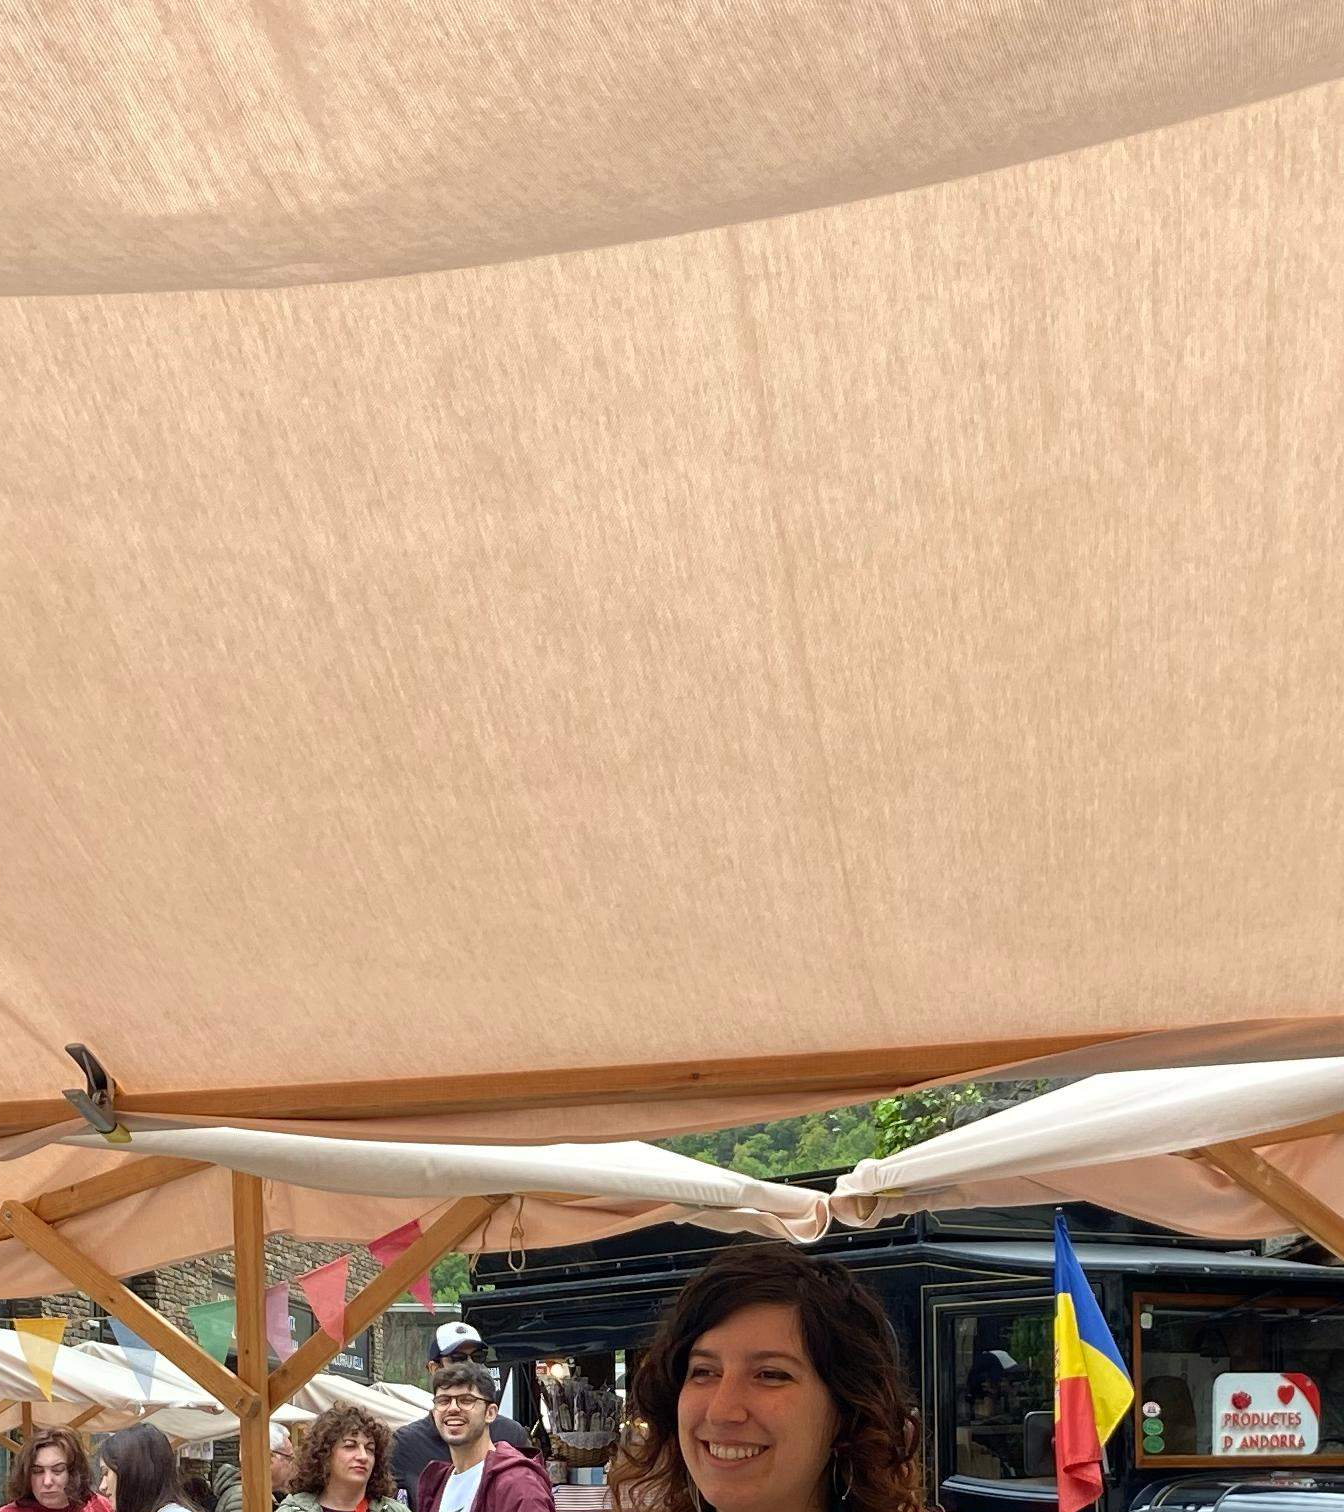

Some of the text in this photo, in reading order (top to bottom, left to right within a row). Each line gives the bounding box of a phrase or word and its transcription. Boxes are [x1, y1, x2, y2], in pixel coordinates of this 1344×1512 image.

[1222, 1411, 1303, 1428] PRODUCTES
[1222, 1433, 1306, 1450] D ANDORRA
